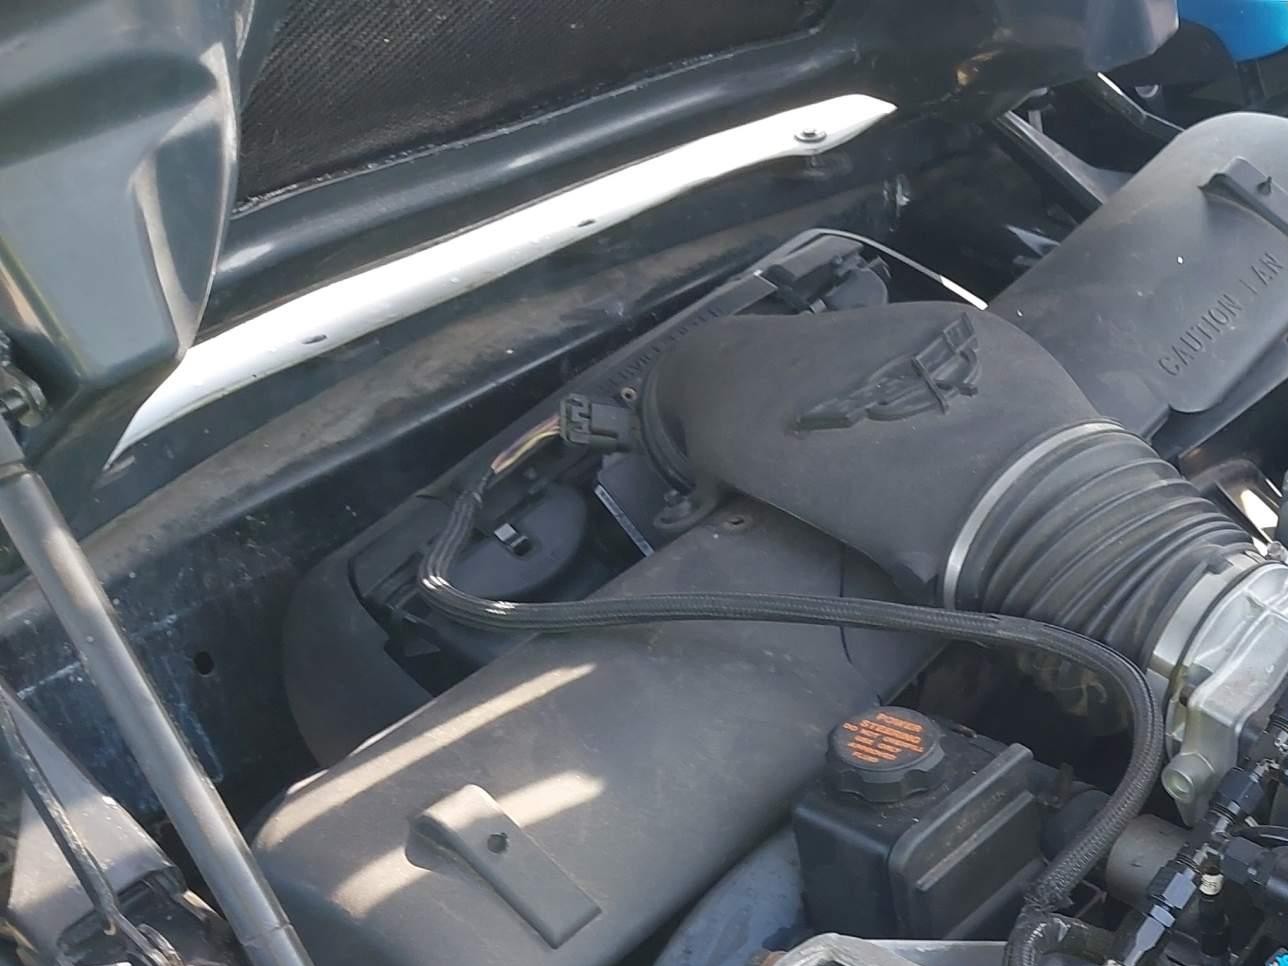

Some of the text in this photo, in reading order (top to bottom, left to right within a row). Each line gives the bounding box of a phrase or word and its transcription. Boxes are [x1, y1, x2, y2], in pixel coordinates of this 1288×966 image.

[1158, 294, 1242, 376] CAUTION
[860, 719, 922, 744] STEERING
[876, 712, 922, 733] POWER
